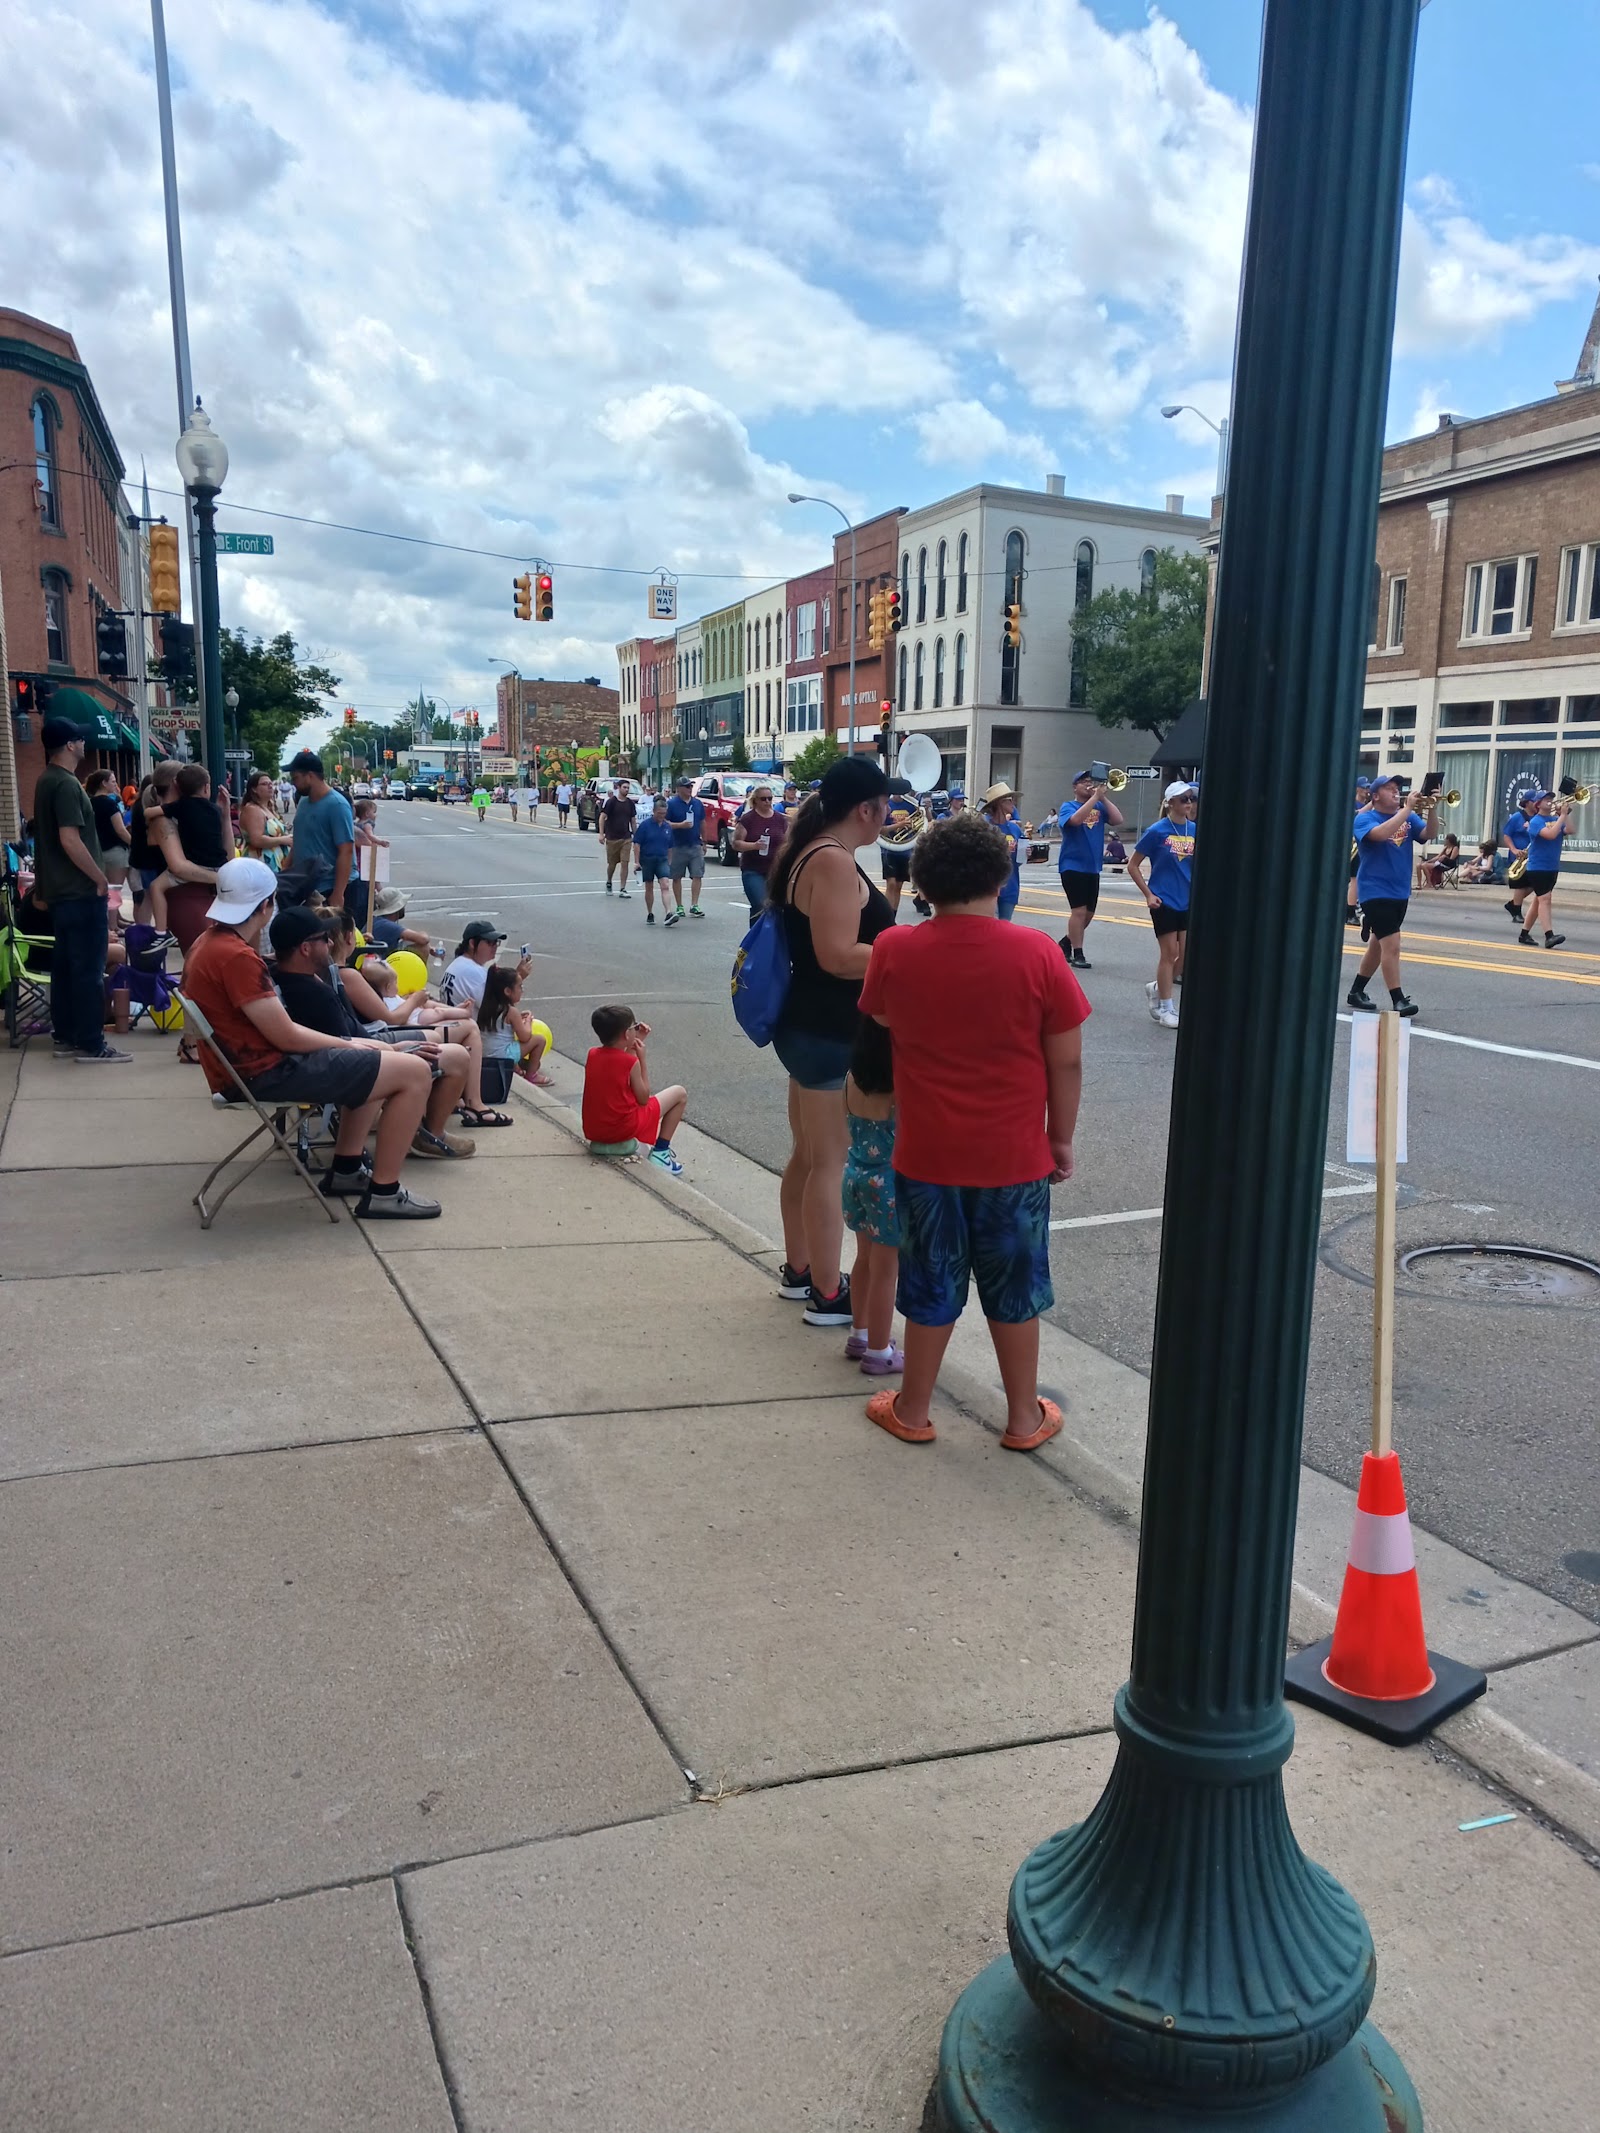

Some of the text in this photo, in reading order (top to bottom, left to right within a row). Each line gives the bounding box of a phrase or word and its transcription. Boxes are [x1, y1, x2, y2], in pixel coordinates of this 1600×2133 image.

[225, 535, 272, 553] E. Front St
[656, 588, 674, 597] ONE
[656, 597, 674, 605] WAY
[151, 718, 177, 729] CHOP
[1517, 772, 1529, 781] OWL
[1579, 840, 1599, 849] EVENTS
